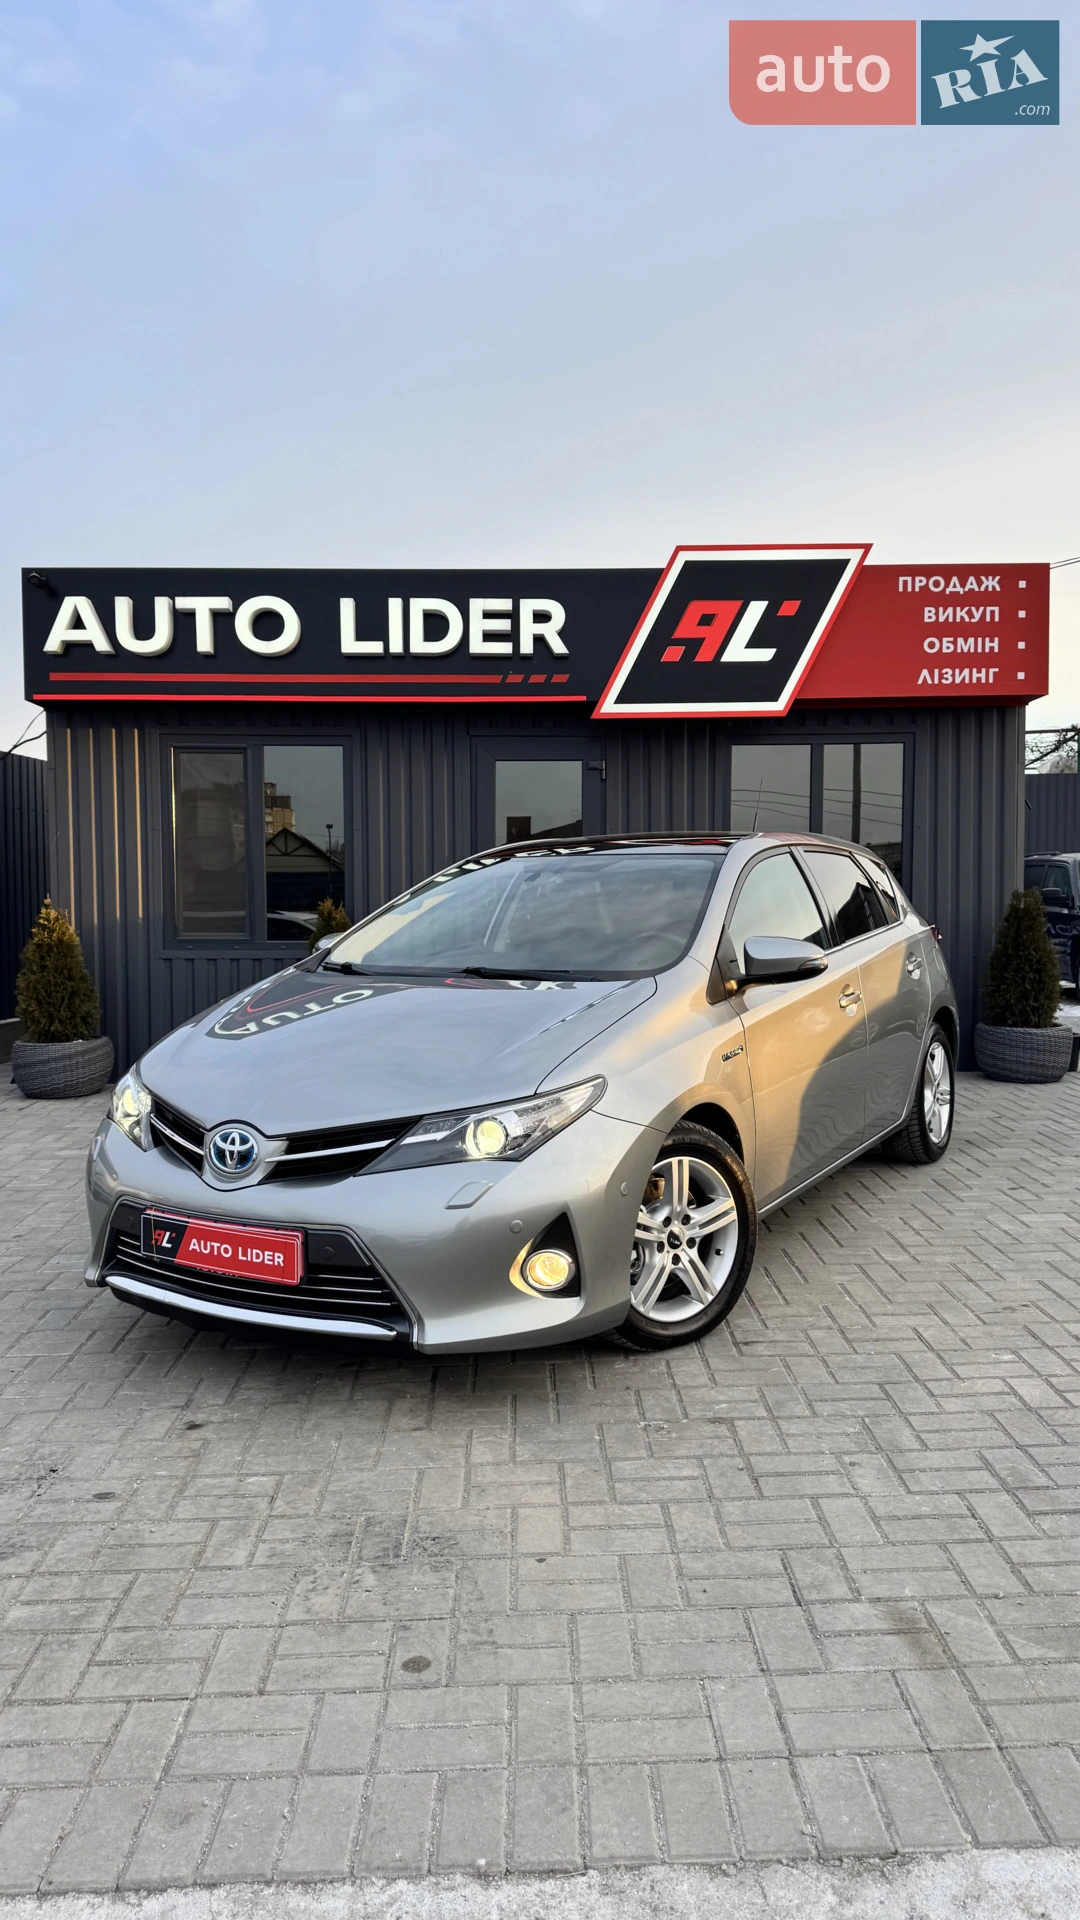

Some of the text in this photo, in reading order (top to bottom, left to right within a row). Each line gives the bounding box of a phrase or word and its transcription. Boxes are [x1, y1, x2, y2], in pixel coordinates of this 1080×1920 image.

[898, 576, 1001, 593] ПРОДАЖ
[923, 606, 1001, 623] ВИКУП
[43, 595, 570, 657] AUTO LIDER
[923, 637, 1000, 654] ОБМІН
[917, 667, 1000, 685] ЛІЗИНГ
[188, 1238, 233, 1258] AUTO
[238, 1246, 285, 1267] LIDER
